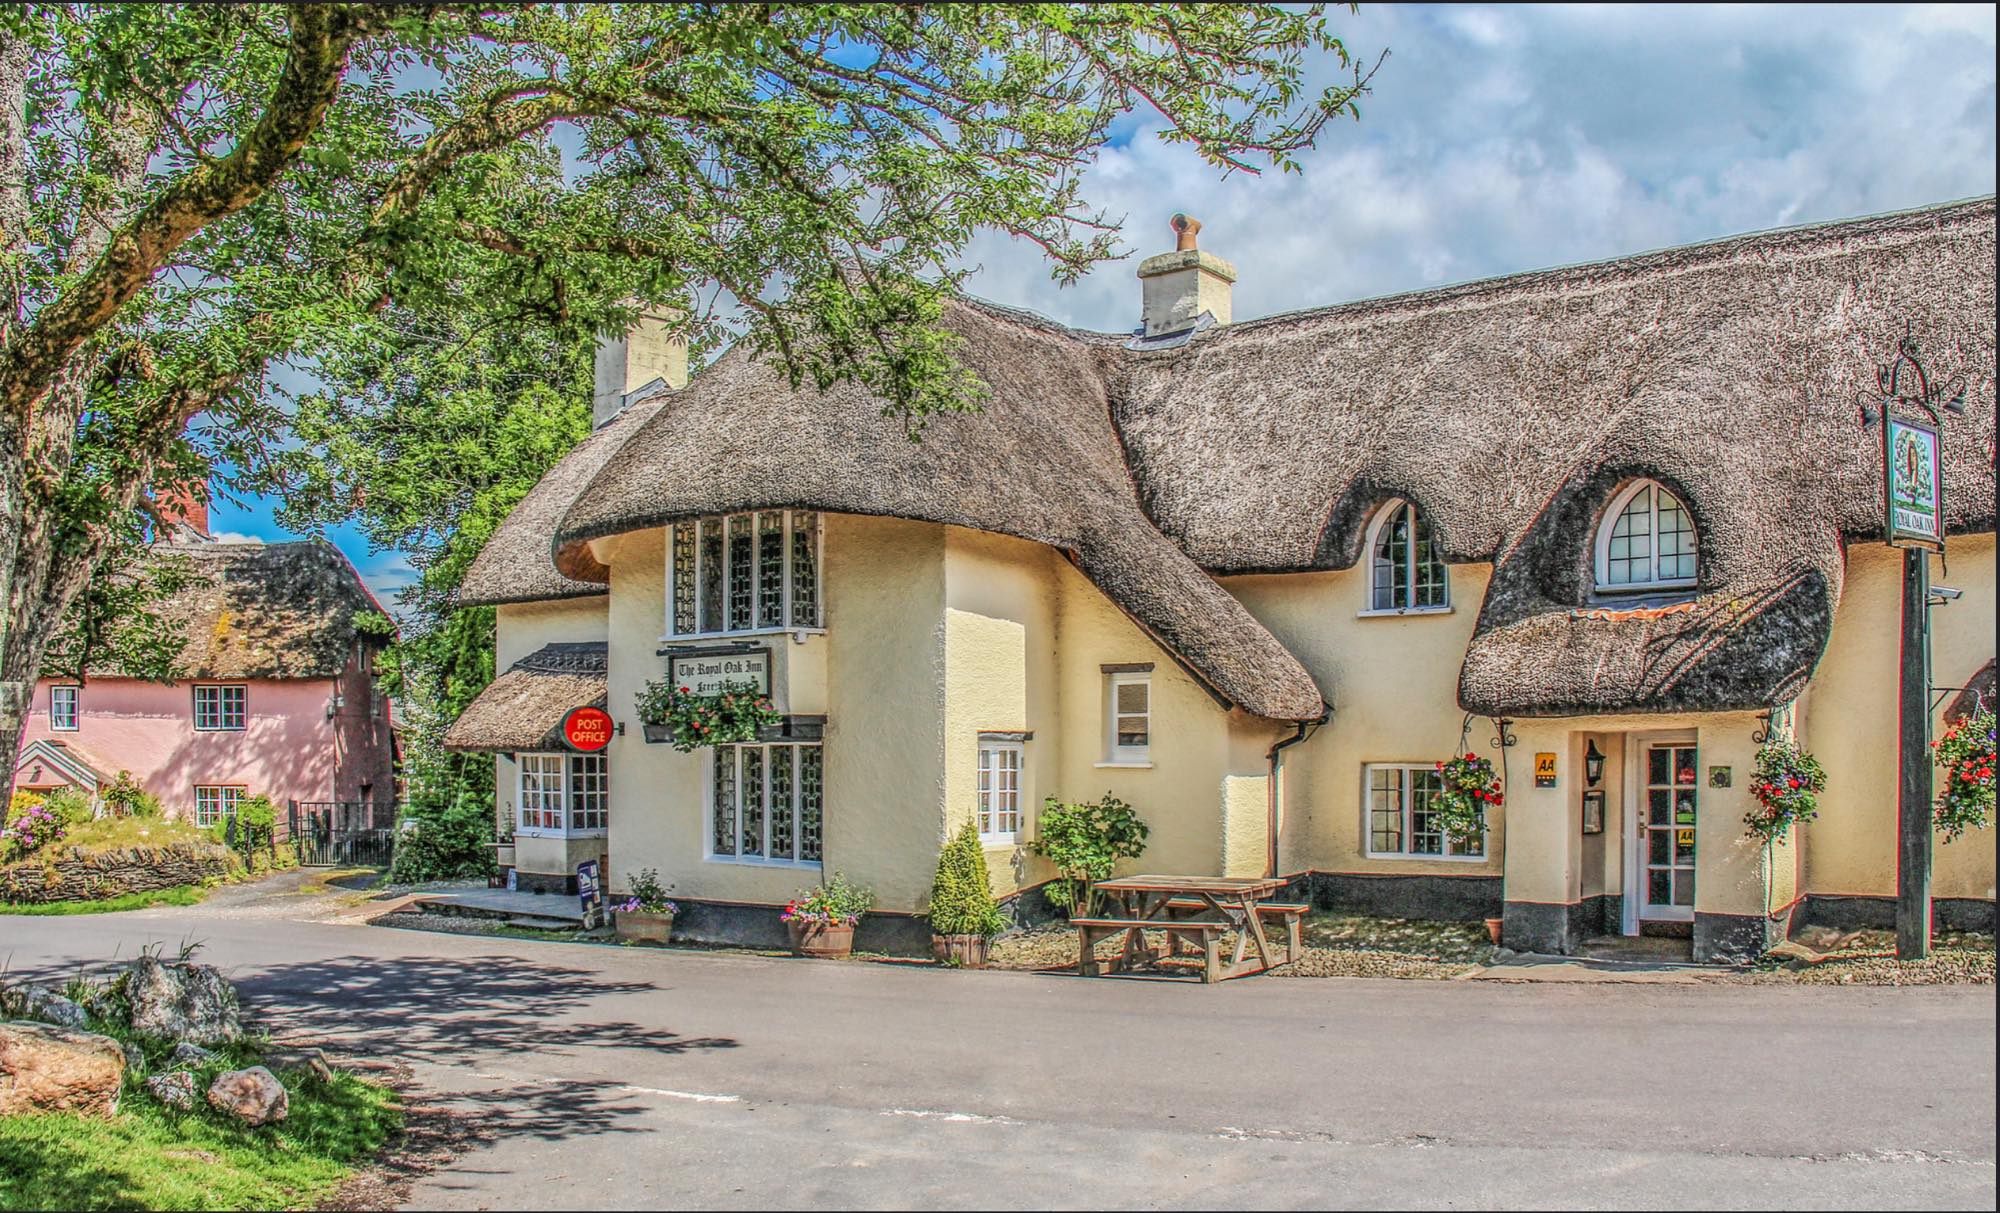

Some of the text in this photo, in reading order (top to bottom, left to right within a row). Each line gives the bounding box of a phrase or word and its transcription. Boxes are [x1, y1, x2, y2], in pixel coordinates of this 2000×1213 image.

[679, 660, 762, 677] The Royal Oak Inn
[577, 719, 603, 730] POST
[571, 731, 606, 743] OFFICE
[1538, 759, 1554, 771] AA
[1680, 831, 1692, 840] AA
